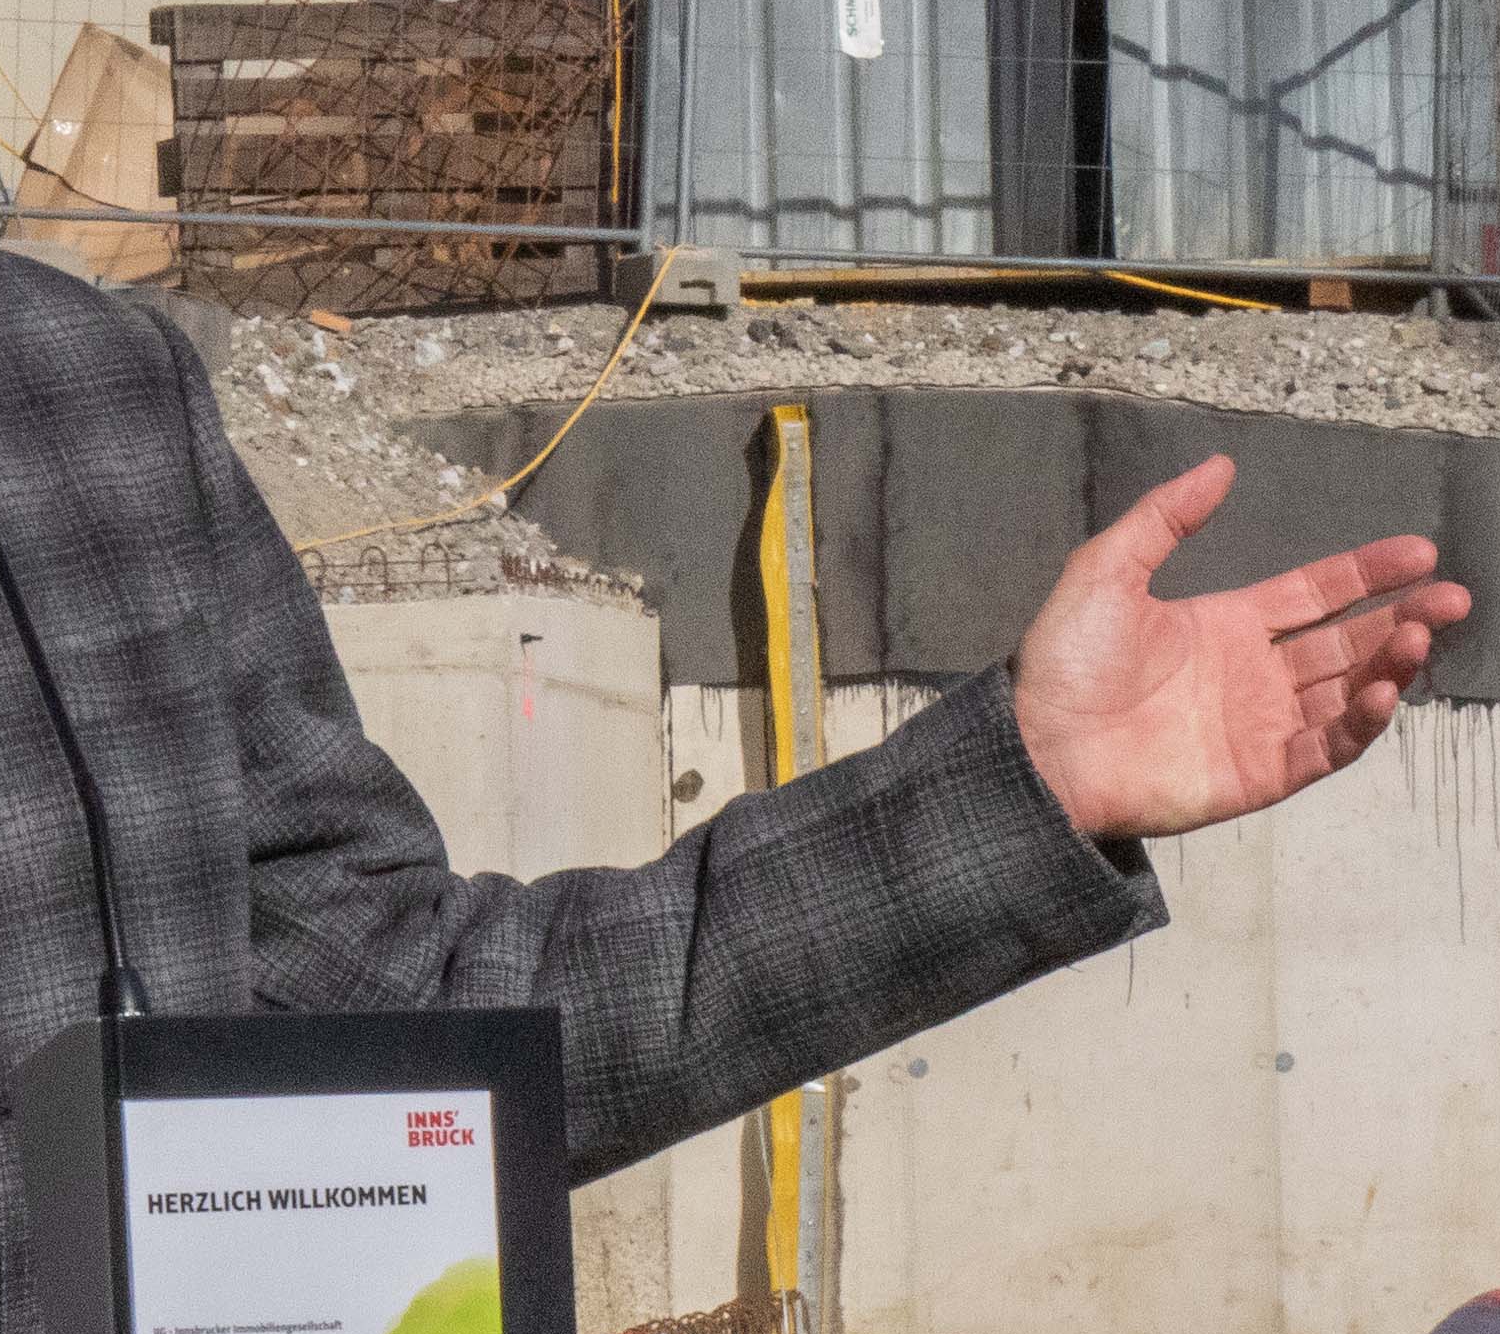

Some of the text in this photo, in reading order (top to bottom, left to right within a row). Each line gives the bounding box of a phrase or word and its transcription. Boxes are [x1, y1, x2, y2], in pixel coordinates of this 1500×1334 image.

[407, 1128, 475, 1148] BRUCK
[148, 1183, 428, 1214] HERZLICH WILLKOMMEN
[233, 1319, 343, 1334] Immobiliengesellschaft
